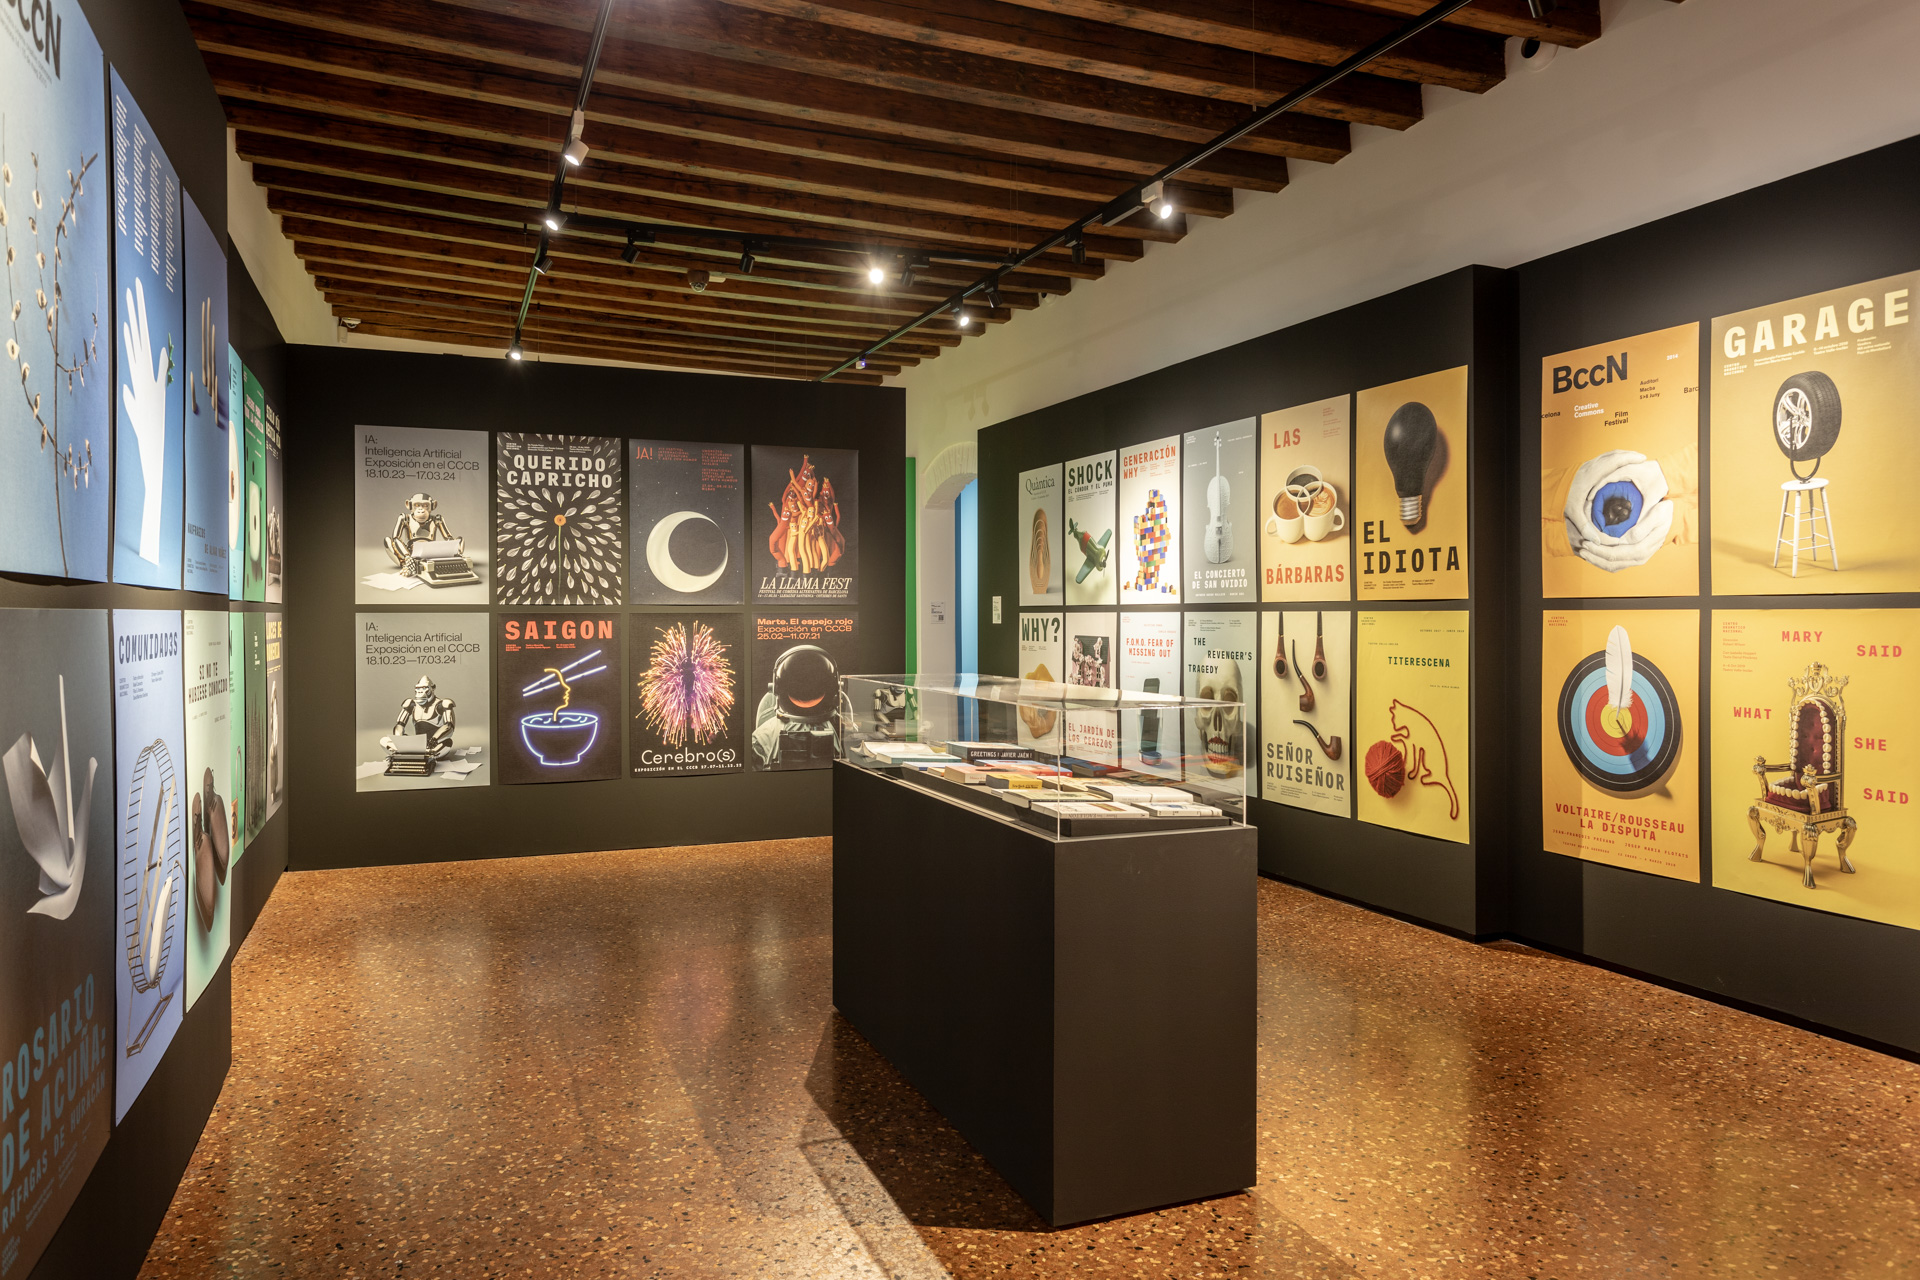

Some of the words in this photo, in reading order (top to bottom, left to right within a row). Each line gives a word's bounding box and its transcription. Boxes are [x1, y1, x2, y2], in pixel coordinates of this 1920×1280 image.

[6, 0, 62, 81] ccN
[1723, 288, 1909, 359] GARAGE
[1553, 351, 1628, 395] BccN
[1574, 402, 1599, 412] Creative
[1574, 408, 1605, 418] Commons
[1614, 410, 1629, 419] Film
[1604, 417, 1629, 427] Festival
[364, 434, 378, 444] IA:
[1273, 428, 1301, 450] LAS
[365, 446, 421, 458] Inteligencia
[423, 448, 462, 459] Artificial
[636, 446, 653, 460] JA!
[1123, 444, 1176, 467] GENERACIÓN
[365, 457, 420, 469] Exposición
[422, 461, 435, 469] en
[436, 460, 446, 469] el
[447, 460, 480, 471] CCCB
[513, 454, 606, 472] QUERIDO
[506, 470, 613, 488] CAPRICHO
[1068, 459, 1113, 487] SHOCK
[1123, 466, 1138, 480] WHY
[1363, 520, 1391, 544] EL
[1363, 545, 1460, 575] IDIOTA
[1194, 571, 1203, 580] EL
[1205, 568, 1246, 579] CONCIERTO
[1266, 563, 1345, 585] BÁRBARAS
[760, 577, 776, 590] LA
[779, 577, 819, 590] LLAMA
[821, 577, 853, 590] FEST
[1192, 580, 1200, 589] DE
[1204, 580, 1218, 589] SAN
[1220, 578, 1248, 588] OVIDIO
[365, 622, 379, 631] IA:
[757, 625, 808, 633] Exposición
[801, 618, 833, 626] espejo
[835, 618, 854, 626] rojo
[505, 620, 613, 640] SAIGON
[1021, 617, 1061, 642] WHY?
[1781, 630, 1824, 643] MARY
[365, 633, 422, 645] Inteligencia
[423, 632, 463, 642] Artificial
[1148, 638, 1164, 647] FEAR
[1166, 639, 1174, 648] OF
[1193, 637, 1206, 646] THE
[118, 631, 178, 665] COMUNIDAD3S
[365, 644, 421, 655] Exposición
[423, 645, 436, 653] en
[437, 644, 446, 653] el
[447, 643, 481, 653] CCCB
[1129, 648, 1155, 657] MISSING
[1159, 649, 1171, 657] OUT
[1856, 644, 1903, 658] SAID
[1207, 650, 1253, 661] REVENGER'S
[1388, 656, 1451, 668] TITERESCENA
[1188, 664, 1219, 674] TRAGEDY
[1733, 706, 1772, 720] WHAT
[1068, 722, 1075, 732] EL
[1079, 724, 1104, 736] JARDÍN
[1106, 728, 1115, 738] DE
[1068, 733, 1080, 743] LOS
[1084, 736, 1113, 749] CEREZOS
[1854, 737, 1888, 751] SHE
[641, 747, 736, 765] Cerebro(s)
[970, 750, 997, 758] GREETINGS
[1266, 741, 1313, 765] SEÑOR
[1266, 761, 1345, 791] RUISEÑOR
[1863, 787, 1910, 805] SAID
[1555, 802, 1685, 834] VOLTAIRE/ROUSSEAU
[1580, 818, 1594, 831] LA
[1602, 823, 1657, 841] DISPUTA
[2, 973, 94, 1123] ROSARIO
[2, 1107, 30, 1195] DE
[40, 1022, 106, 1142] ACUÑA:
[2, 1149, 48, 1234] RÁFAGAS
[54, 1124, 66, 1158] DE
[70, 1068, 105, 1134] HURACÁN
